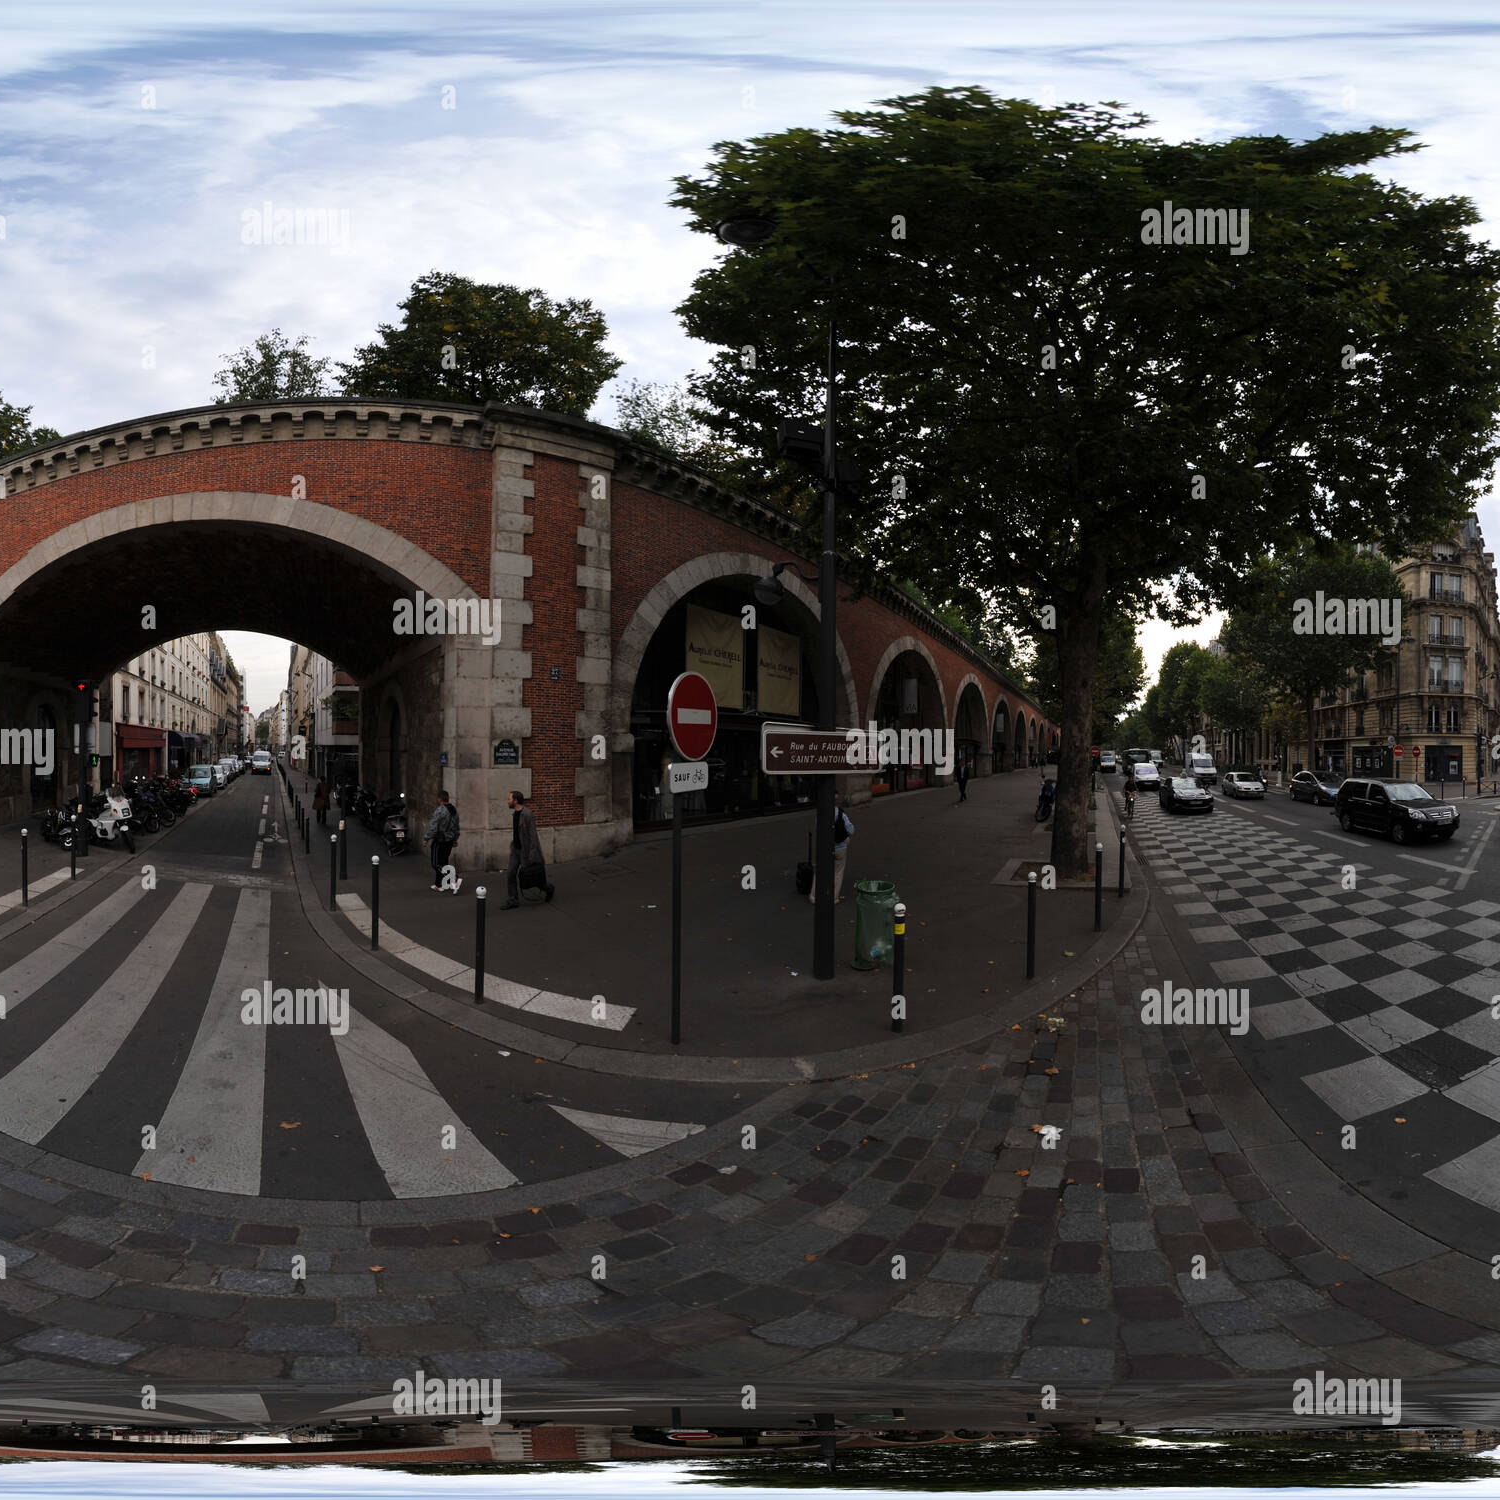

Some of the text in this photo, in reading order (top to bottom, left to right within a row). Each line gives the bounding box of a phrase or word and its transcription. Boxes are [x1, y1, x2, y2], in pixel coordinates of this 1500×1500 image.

[790, 742, 804, 751] Rue
[809, 742, 818, 751] du
[674, 772, 690, 782] SAUF
